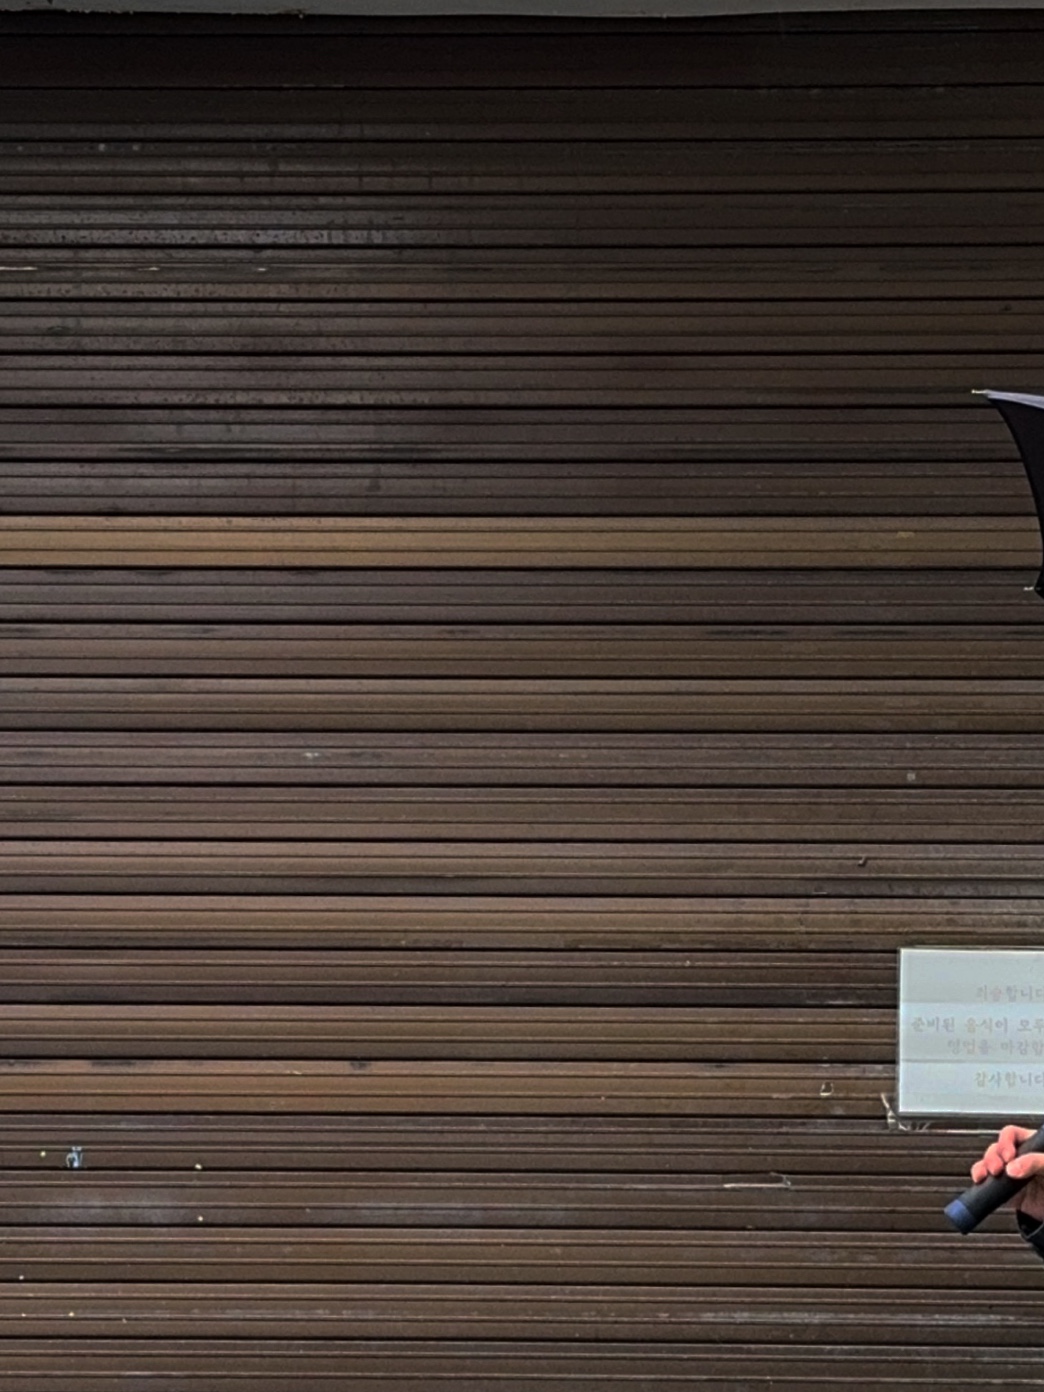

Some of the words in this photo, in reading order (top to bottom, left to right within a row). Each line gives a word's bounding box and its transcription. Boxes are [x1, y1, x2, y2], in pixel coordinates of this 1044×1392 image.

[911, 1016, 956, 1033] 준비된
[965, 1017, 1008, 1034] 음식이
[948, 1038, 992, 1055] 영업을
